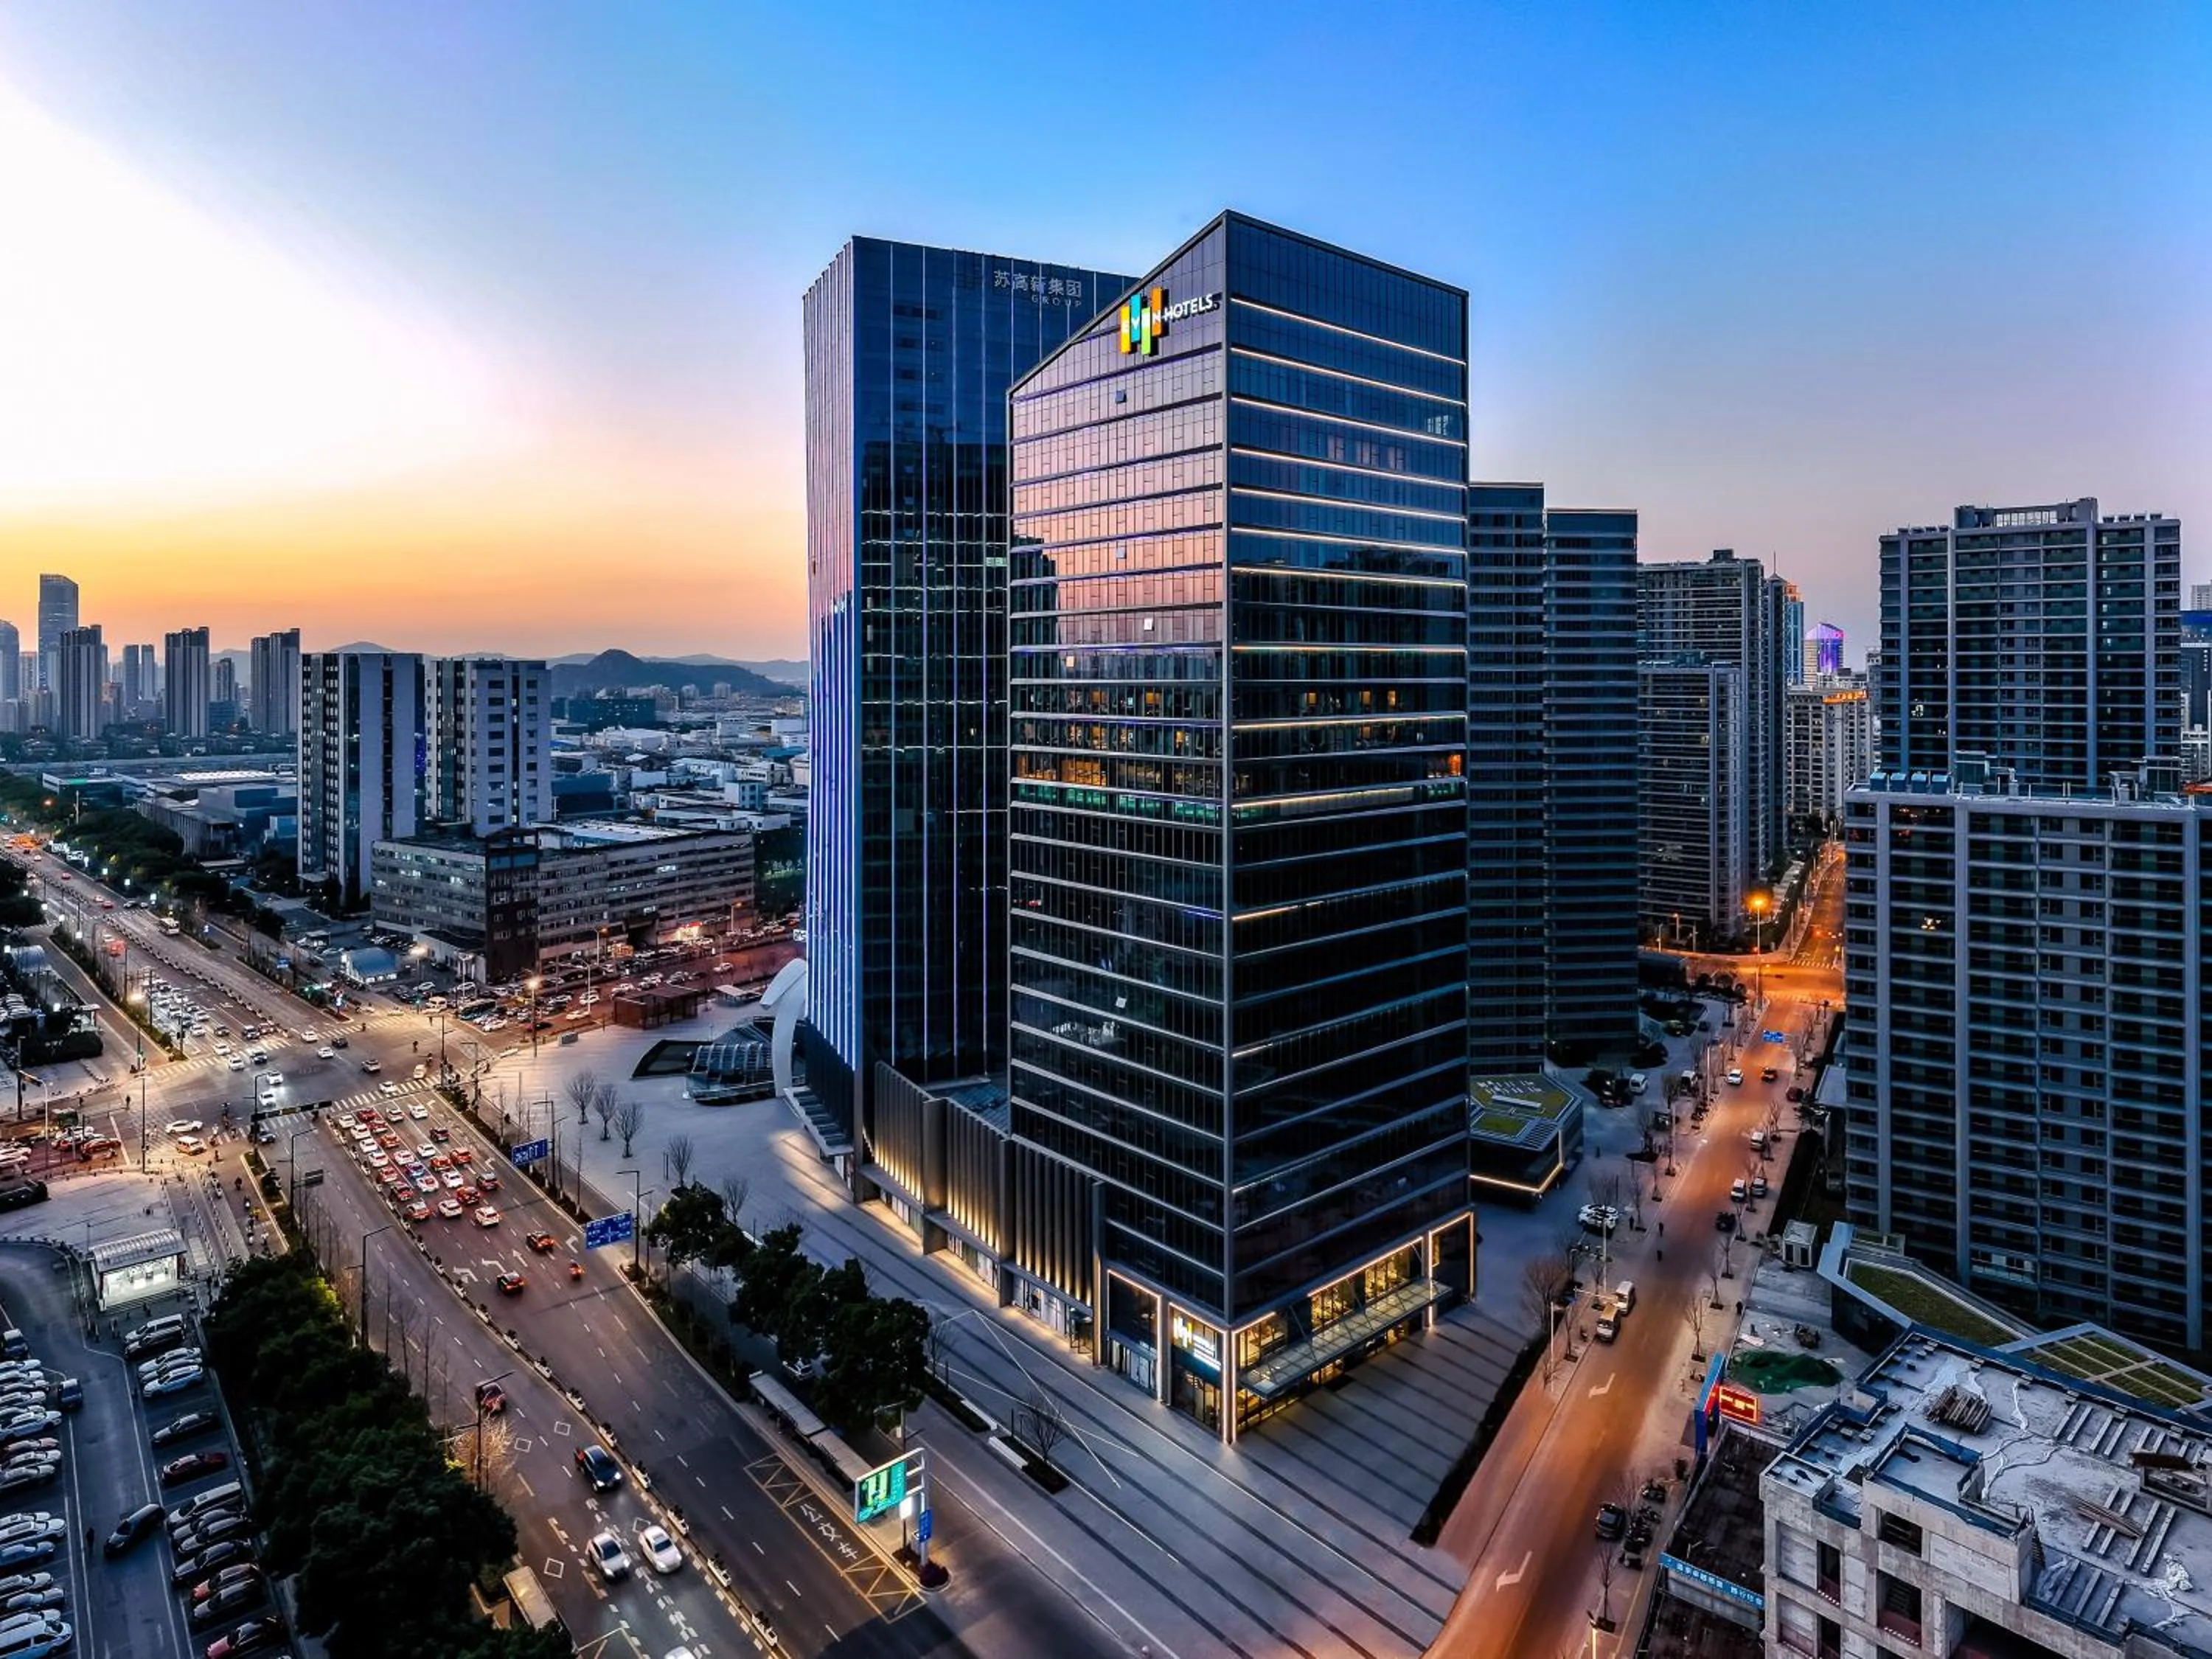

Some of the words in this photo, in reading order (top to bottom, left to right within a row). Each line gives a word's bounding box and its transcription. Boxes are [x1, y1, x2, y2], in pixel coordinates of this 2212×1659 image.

[993, 271, 1082, 297] 苏高新集团
[1032, 295, 1082, 307] GROUP
[1164, 293, 1213, 321] HOTELS
[800, 1503, 858, 1559] 公交车
